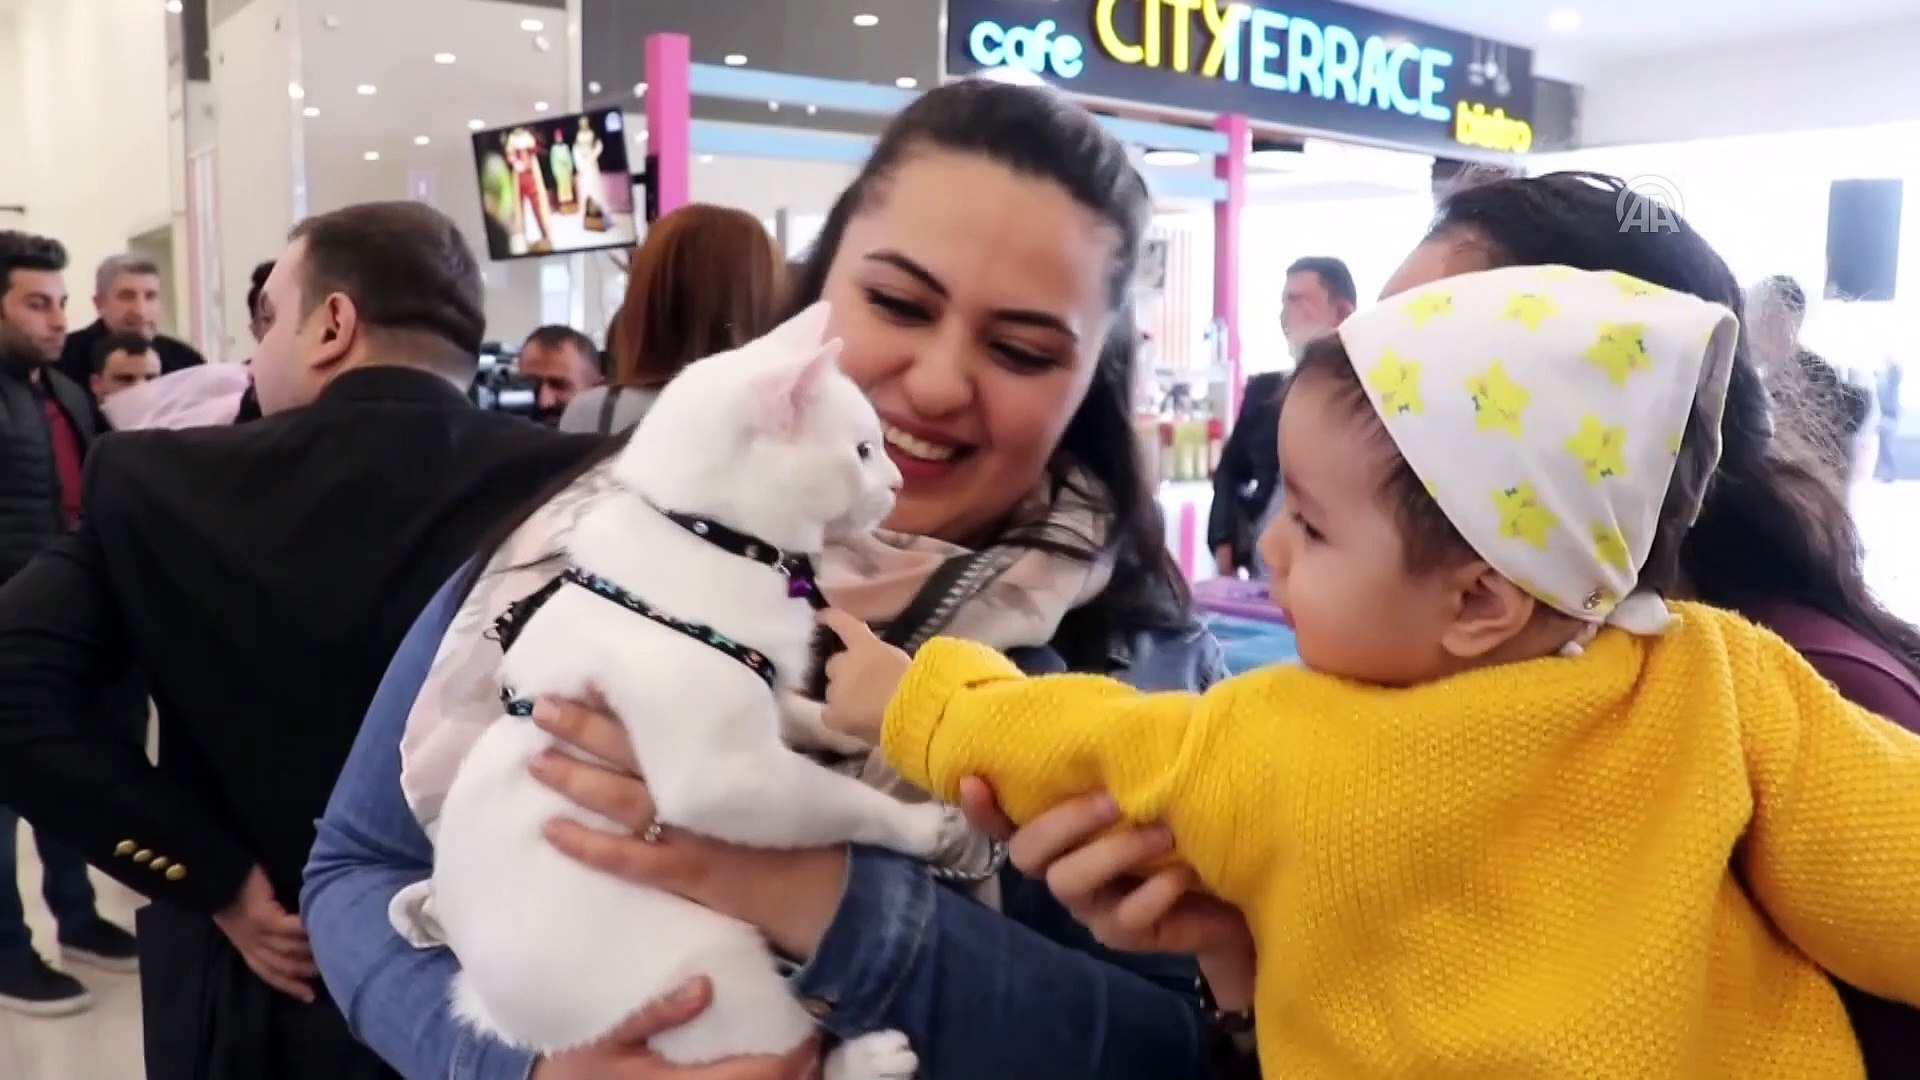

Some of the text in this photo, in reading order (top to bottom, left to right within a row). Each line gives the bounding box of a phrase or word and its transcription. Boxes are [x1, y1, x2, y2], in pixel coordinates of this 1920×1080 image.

[969, 20, 1083, 79] cafe
[1095, 0, 1453, 121] CITY TERRACE
